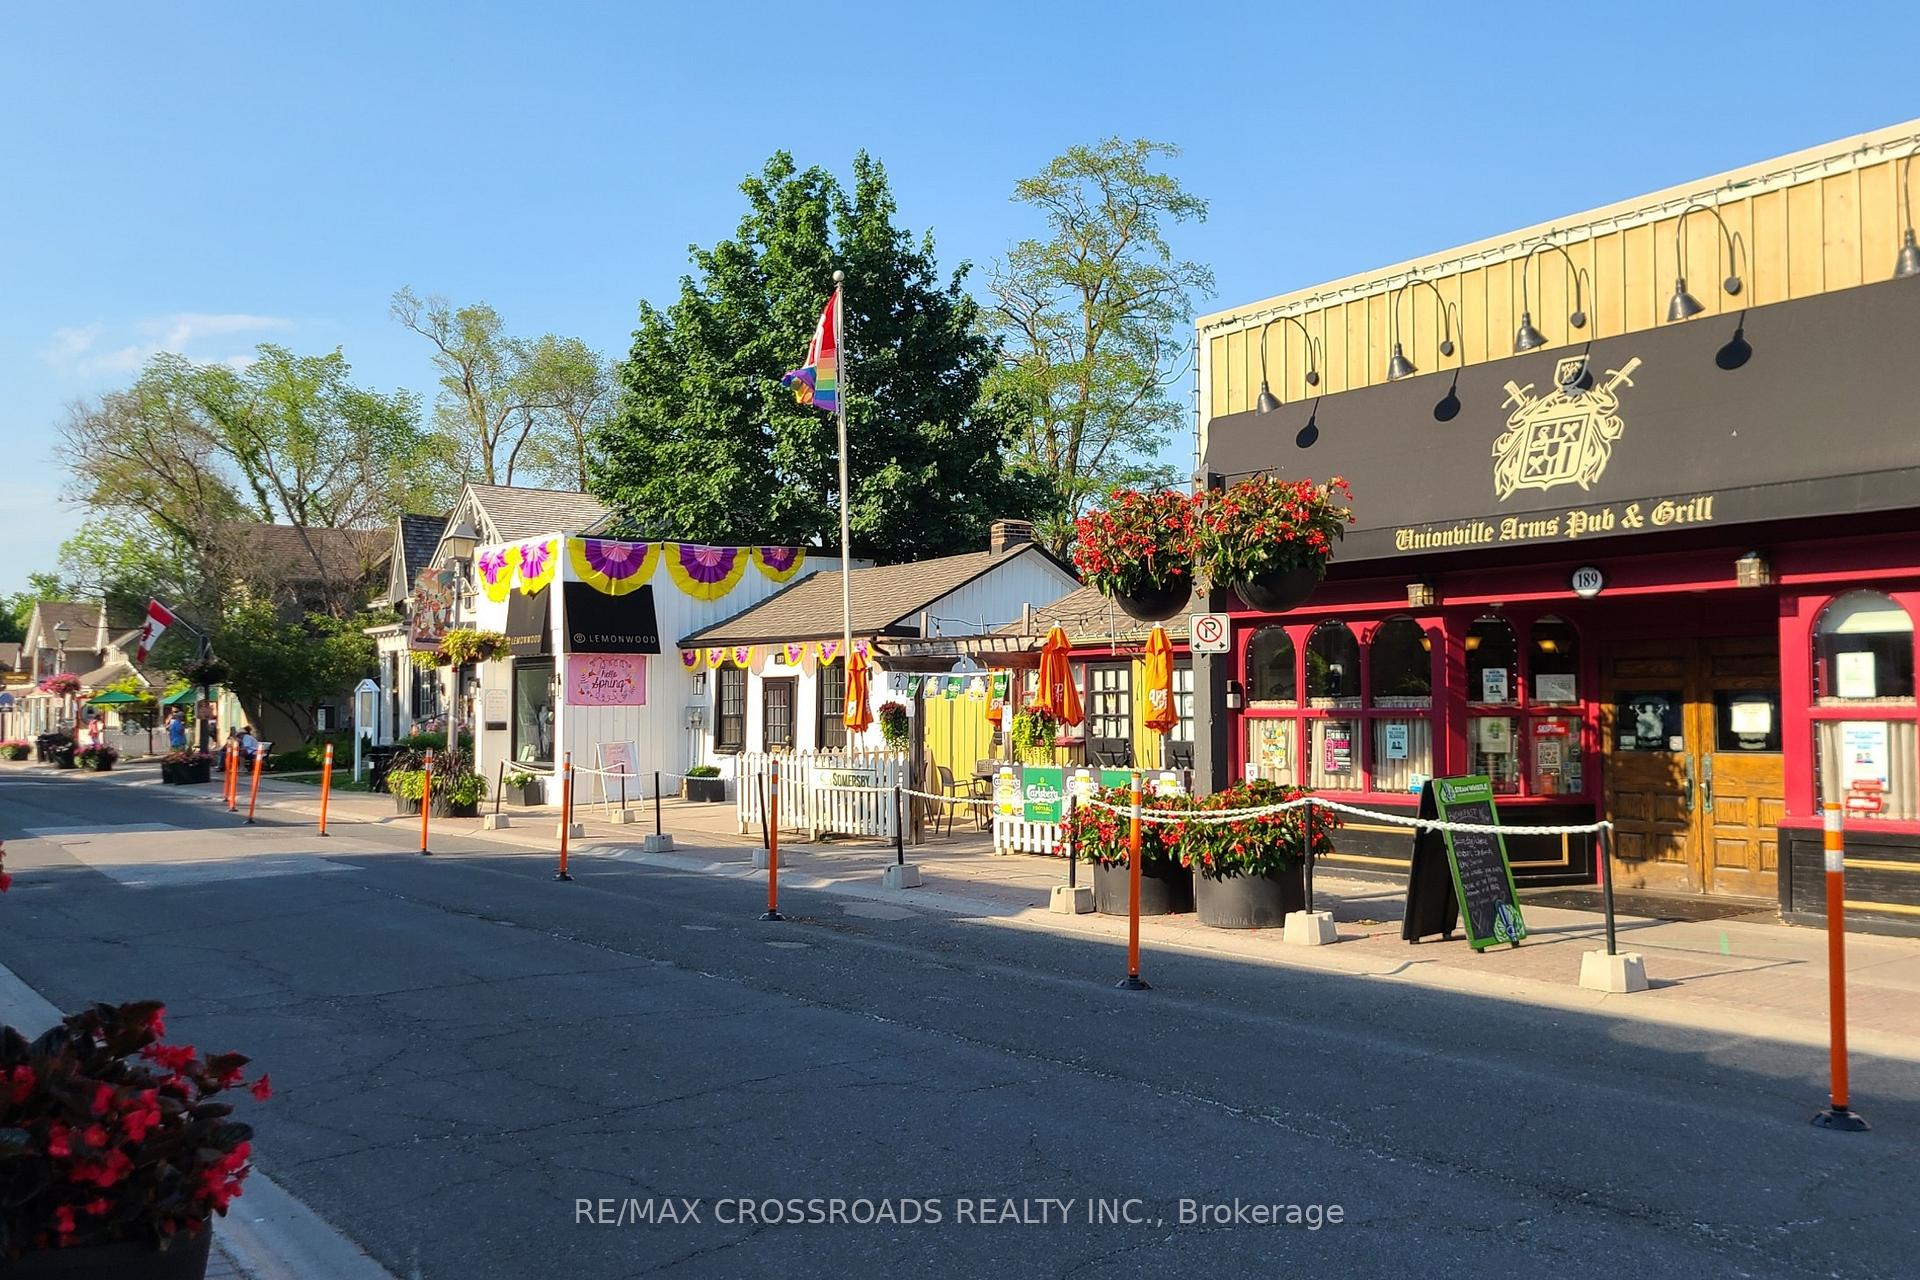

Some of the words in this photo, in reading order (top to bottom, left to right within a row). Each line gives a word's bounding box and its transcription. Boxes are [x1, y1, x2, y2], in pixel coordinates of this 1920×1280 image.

[1395, 521, 1494, 551] Unionville
[1499, 515, 1560, 541] Arms
[1564, 507, 1615, 539] Pub
[1621, 502, 1645, 529] &
[1651, 495, 1714, 526] Grill
[1577, 572, 1599, 588] 189
[511, 634, 542, 646] LEMONWOOD
[589, 634, 657, 645] LEMONWOOD
[832, 772, 872, 788] SOMERSBY
